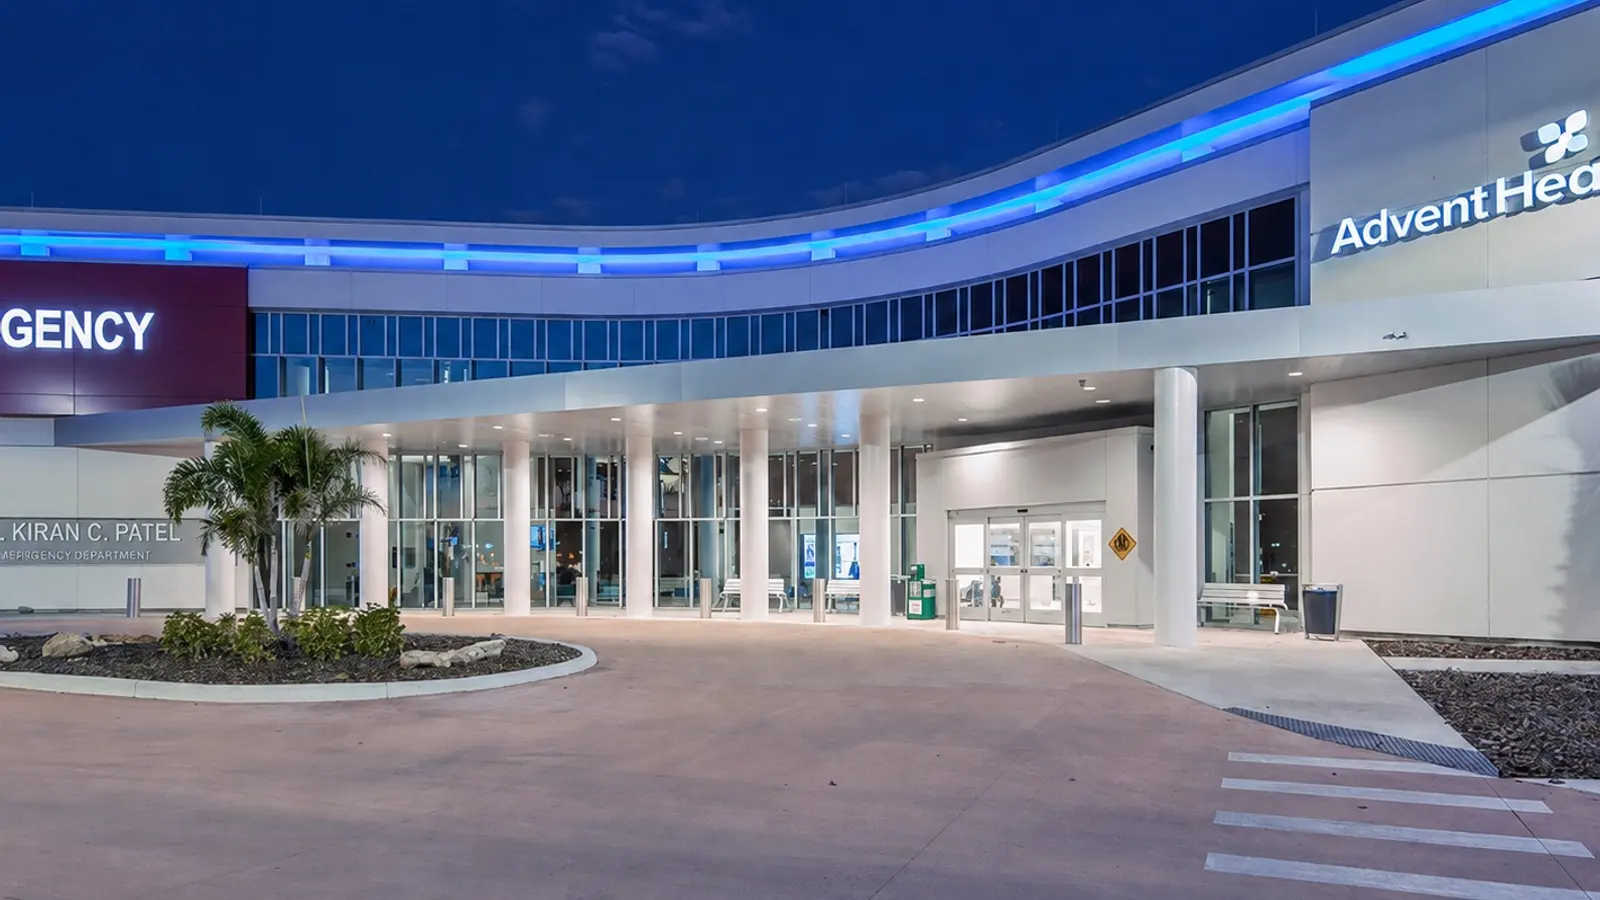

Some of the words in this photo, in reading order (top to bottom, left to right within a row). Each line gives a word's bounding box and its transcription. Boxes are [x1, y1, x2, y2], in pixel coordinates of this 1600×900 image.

[1, 308, 155, 350] GENCY
[13, 522, 80, 541] KIRAN
[88, 522, 109, 541] C.
[116, 522, 182, 542] PATEL
[75, 550, 151, 561] DEPARTMENT
